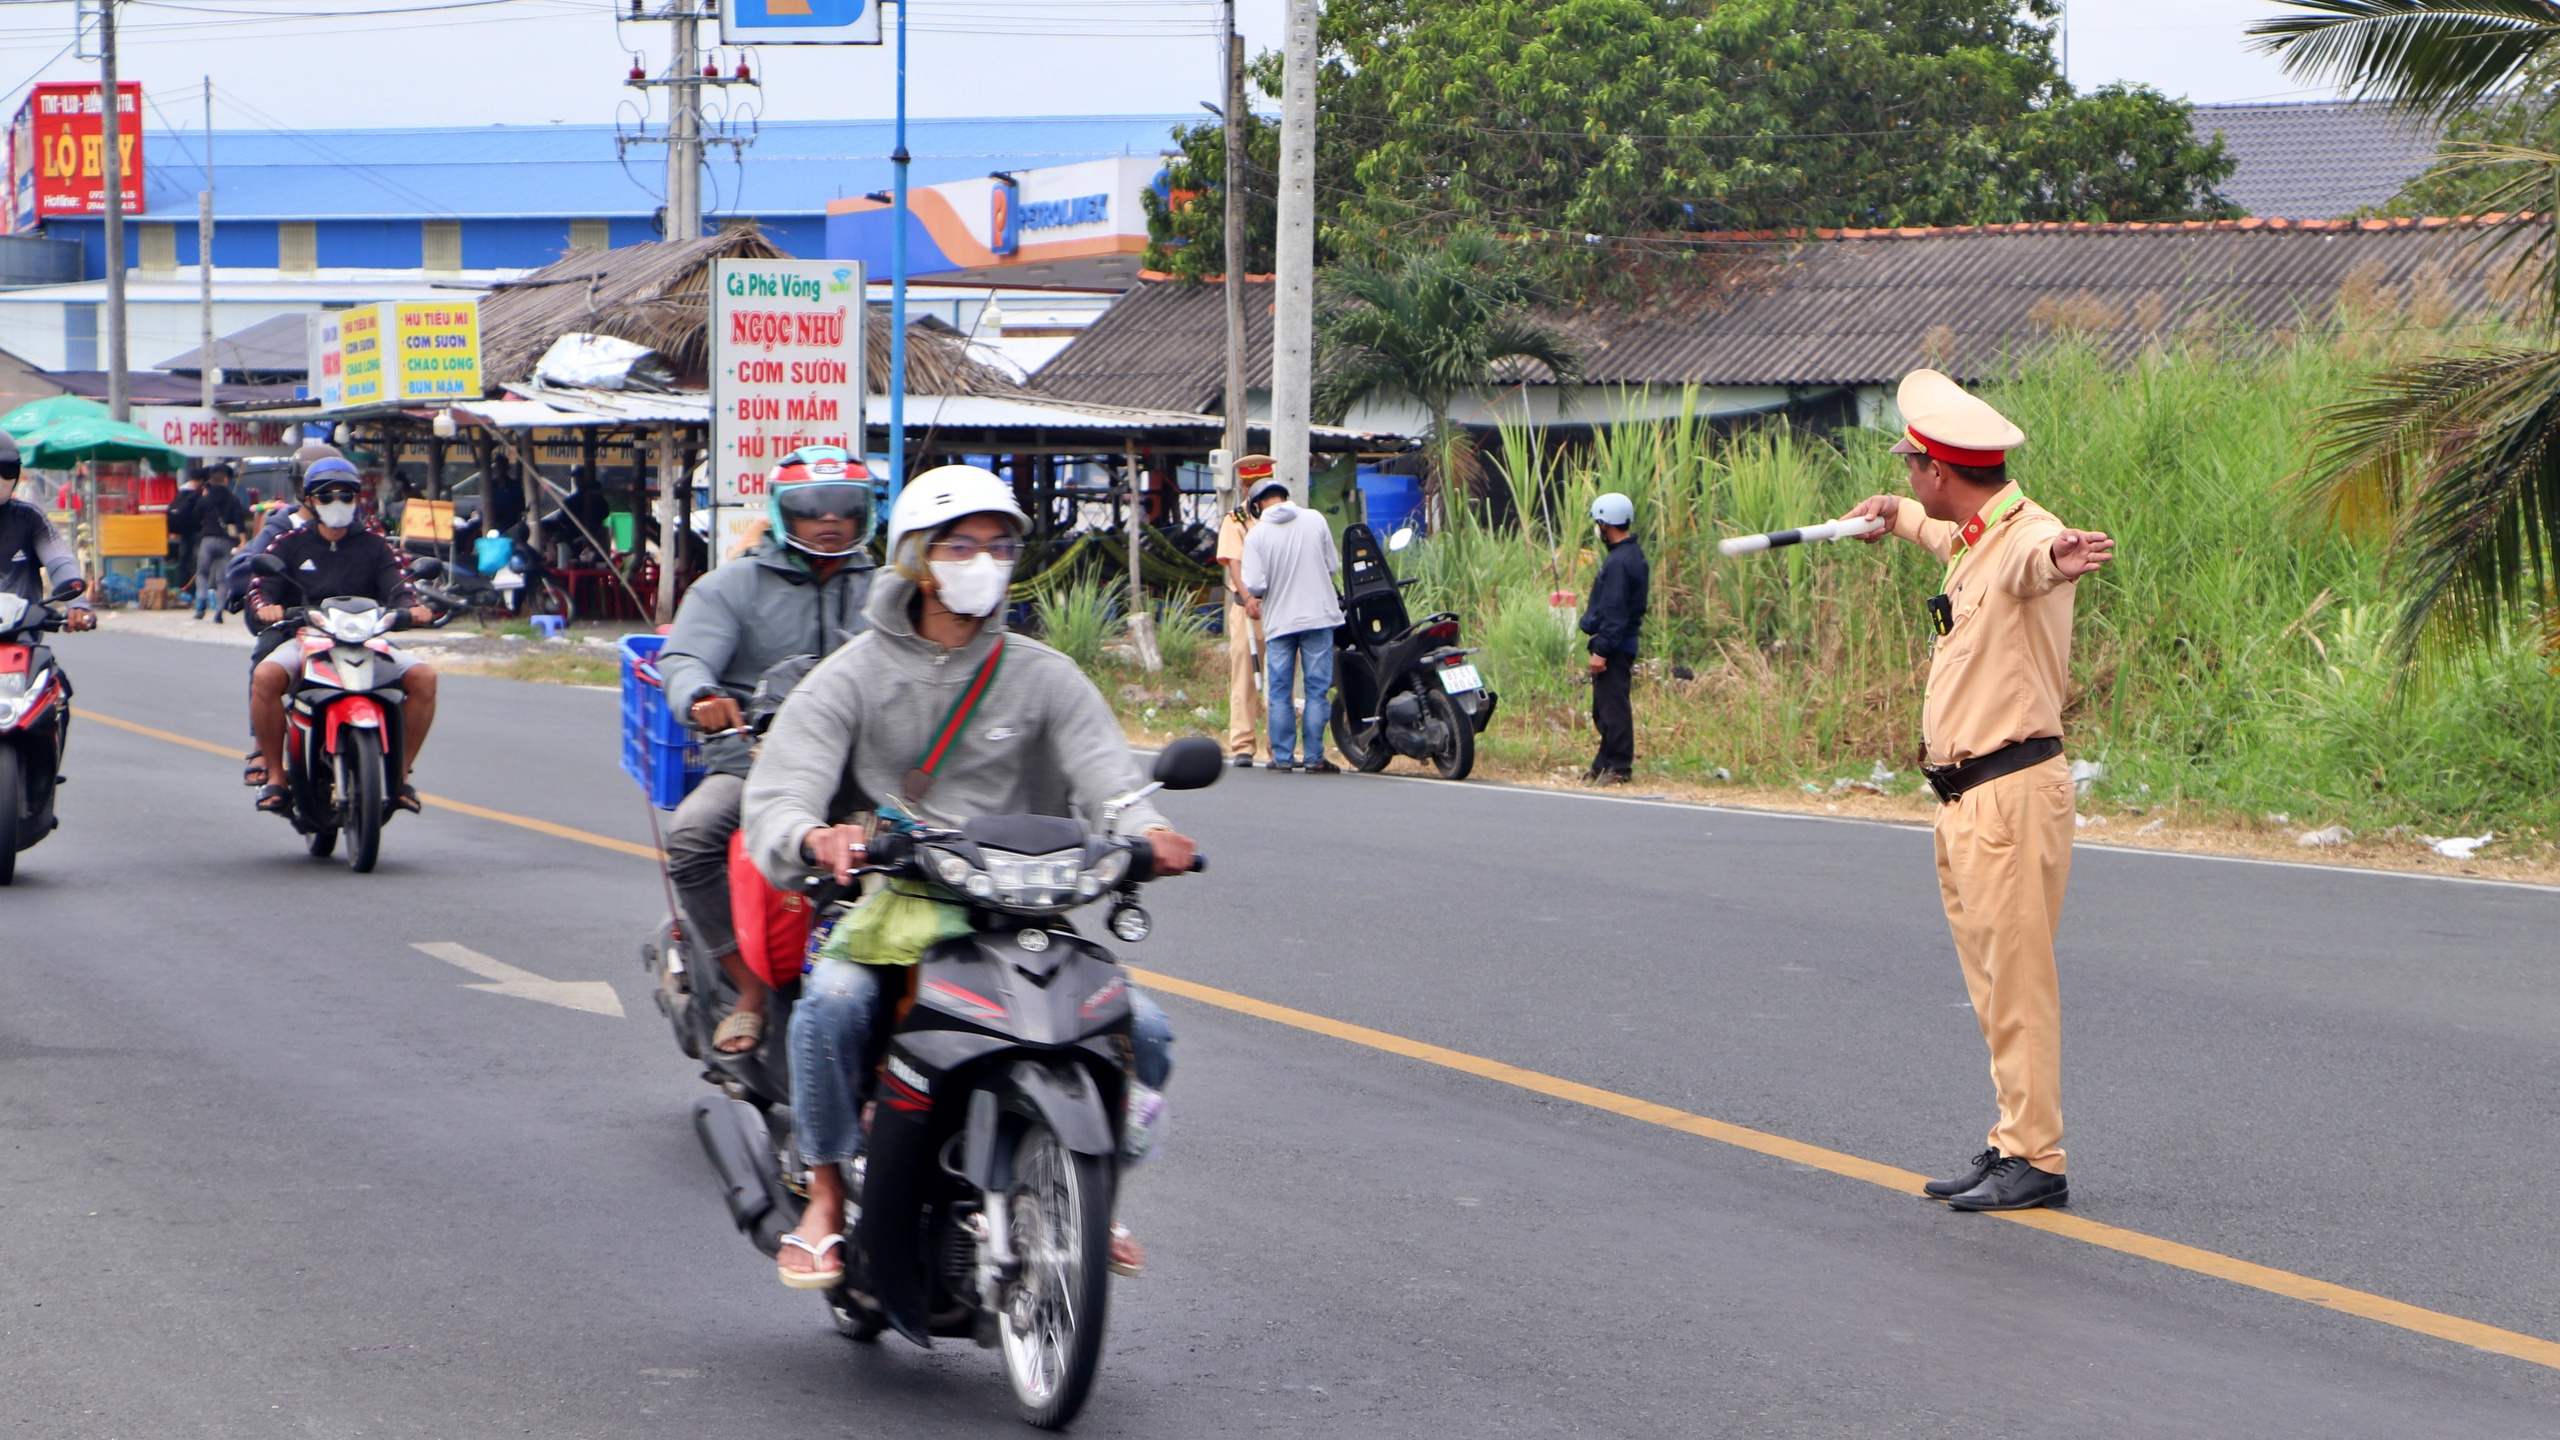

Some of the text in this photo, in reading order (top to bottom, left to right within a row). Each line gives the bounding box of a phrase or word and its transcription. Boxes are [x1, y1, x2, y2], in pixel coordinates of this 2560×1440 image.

[43, 123, 77, 187] LỘ
[81, 134, 135, 177] HY
[727, 272, 821, 302] Cà Phê Võng
[730, 305, 846, 352] NGỌC NHƯ
[738, 357, 846, 384] CƠM SƯỜN
[738, 391, 838, 421] BÚN MẮM
[163, 417, 183, 445] CÀ
[190, 417, 219, 446] PHÊ
[738, 427, 765, 458] HỦ
